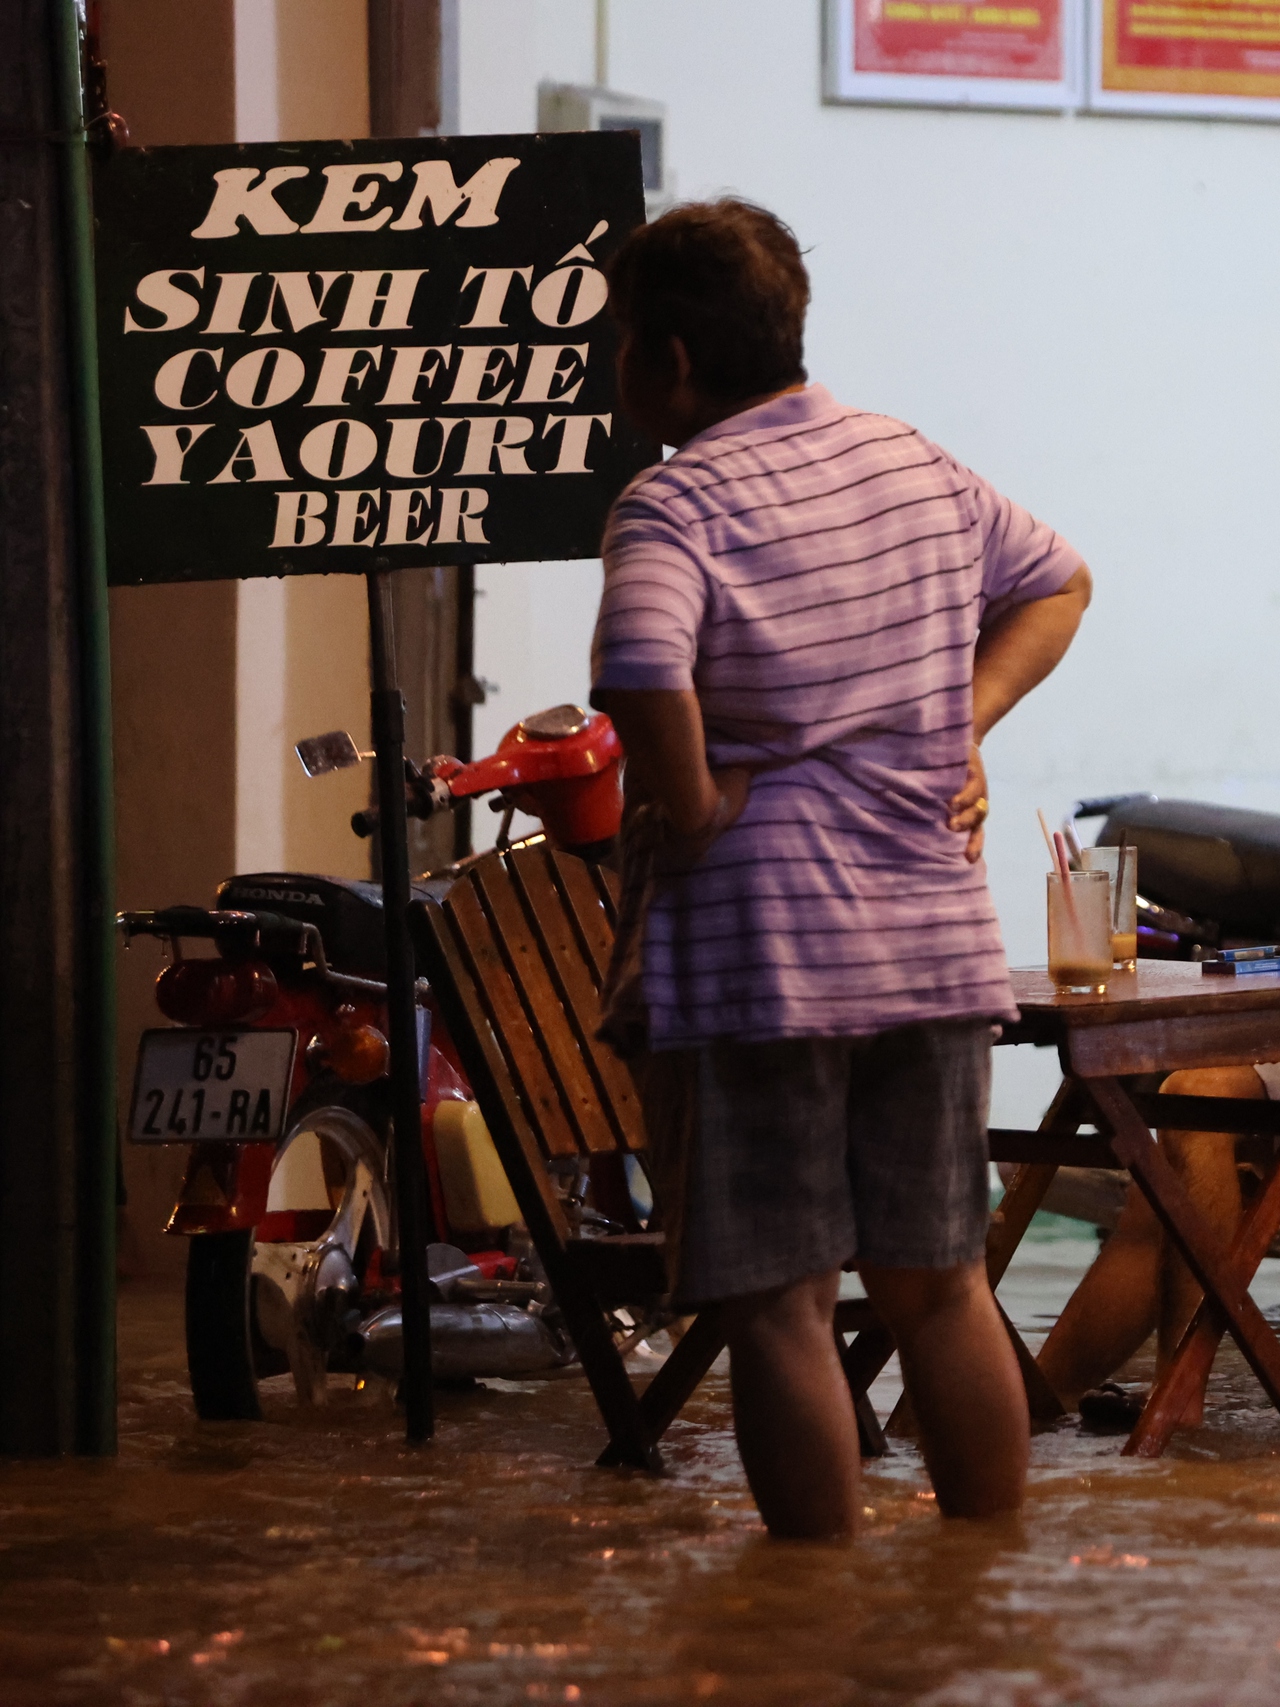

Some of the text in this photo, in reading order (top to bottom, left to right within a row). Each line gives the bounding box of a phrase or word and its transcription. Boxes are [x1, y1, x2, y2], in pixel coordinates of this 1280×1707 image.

[191, 157, 520, 239] KEM
[124, 219, 609, 336] SINH TỐ
[154, 342, 589, 410] COFFEE
[140, 412, 612, 485] YAOURT
[268, 486, 490, 548] BEER
[231, 886, 325, 906] HONDA
[193, 1035, 238, 1082] 65
[142, 1088, 270, 1135] 241-RA
